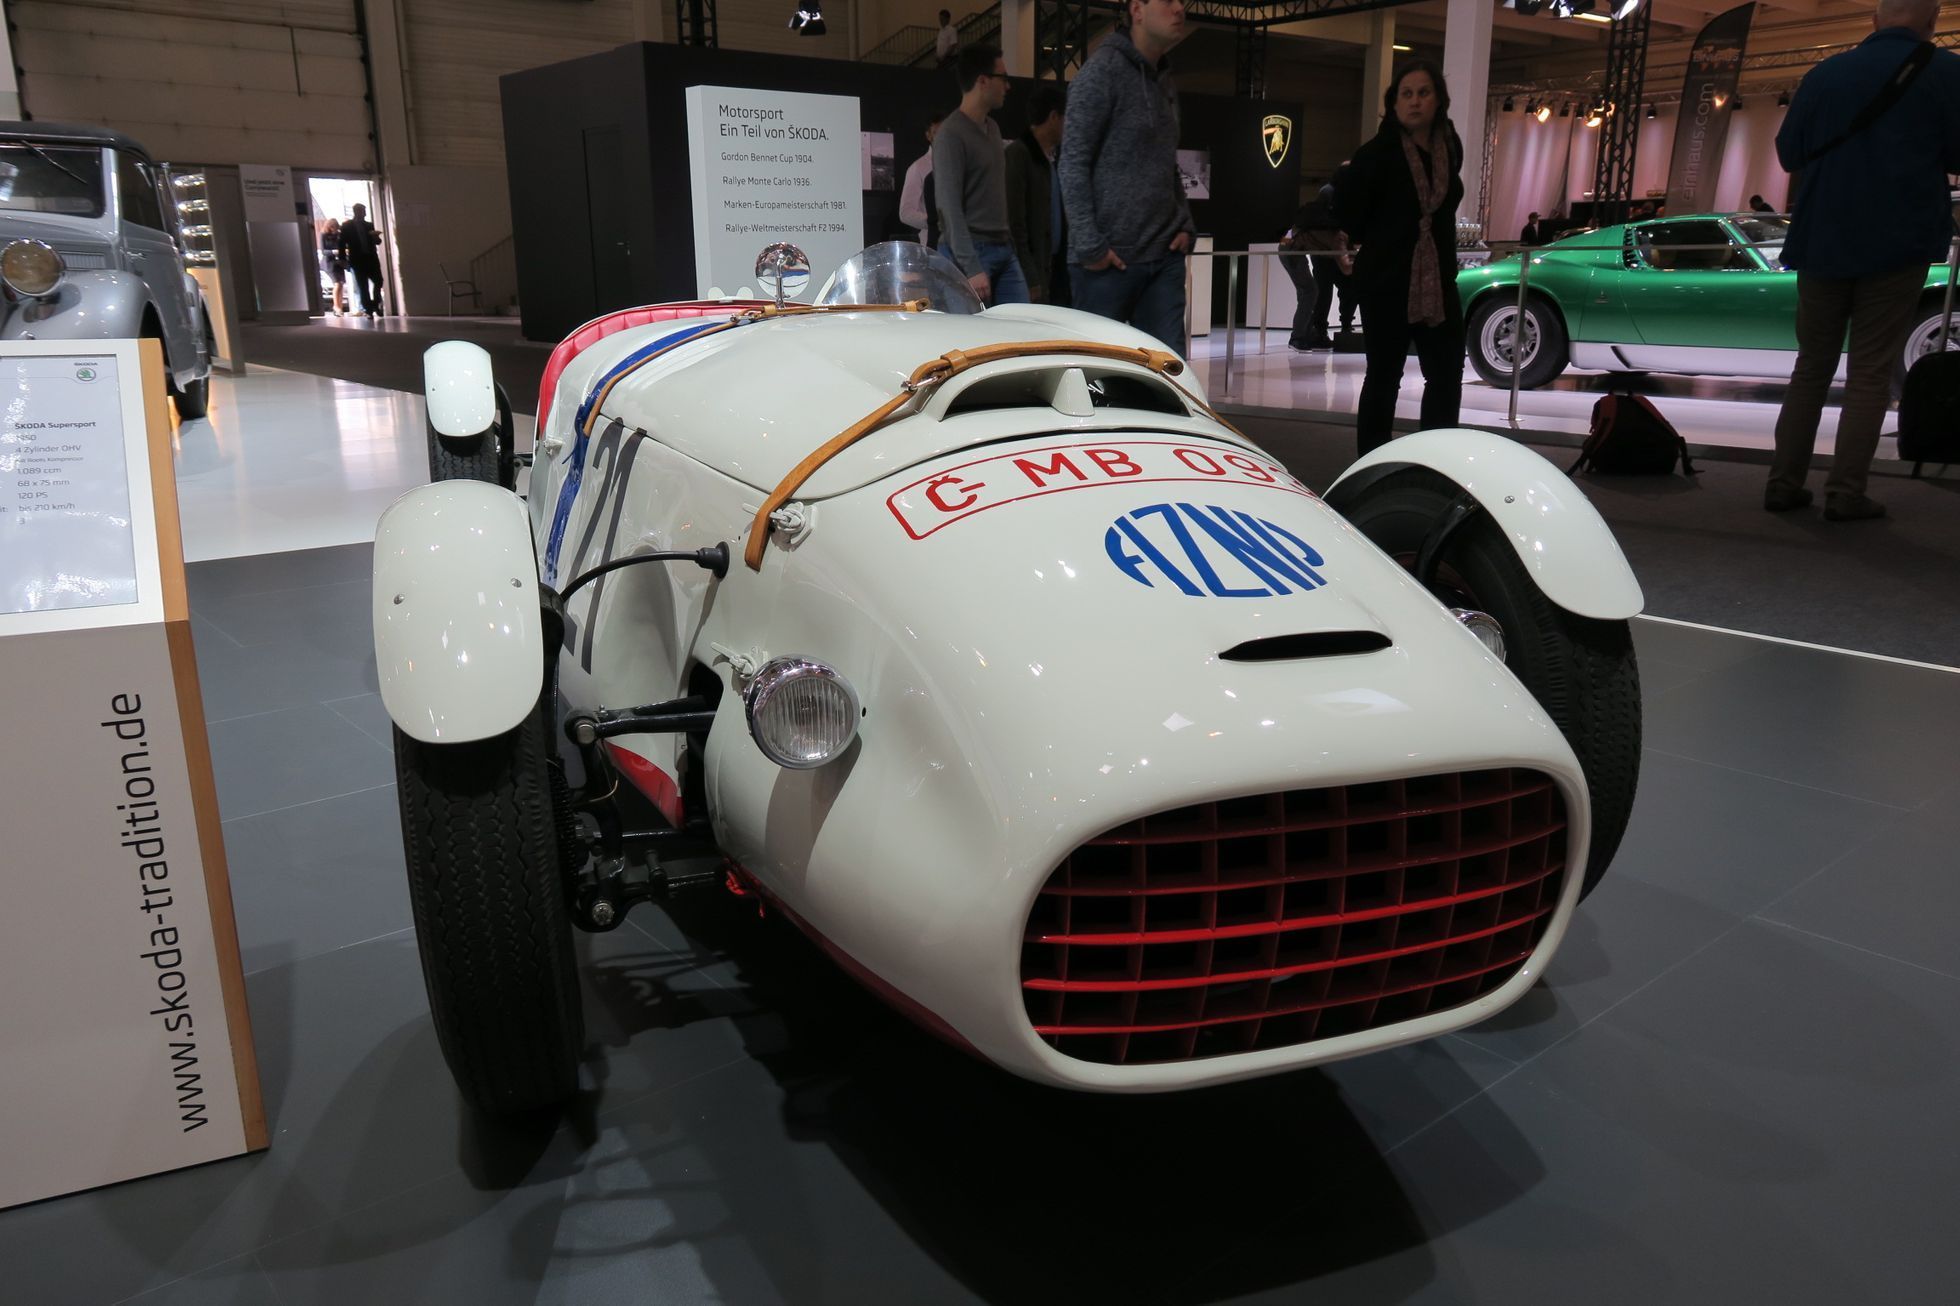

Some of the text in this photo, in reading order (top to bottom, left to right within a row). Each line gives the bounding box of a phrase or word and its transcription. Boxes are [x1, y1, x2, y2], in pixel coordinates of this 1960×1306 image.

[719, 104, 784, 122] Motorsport
[720, 124, 829, 141] Ein Teil von ŠKODA.
[721, 152, 814, 164] Gordon Bennet Cup 1904.
[722, 176, 746, 187] Rallye
[747, 177, 772, 186] Monte
[773, 177, 792, 186] Carlo
[724, 200, 829, 211] Marken-Europameisterschaft
[725, 223, 817, 234] Rallye-Weltmeisterschaft
[818, 224, 827, 233] F2
[48, 421, 96, 430] Supersport
[24, 445, 59, 455] Zylinder
[1013, 448, 1143, 489] MB
[36, 491, 48, 499] PS
[19, 504, 32, 512] bis
[34, 503, 50, 511] 210
[52, 502, 76, 510] km/h
[101, 693, 209, 1133] www.skoda-tradition.de
